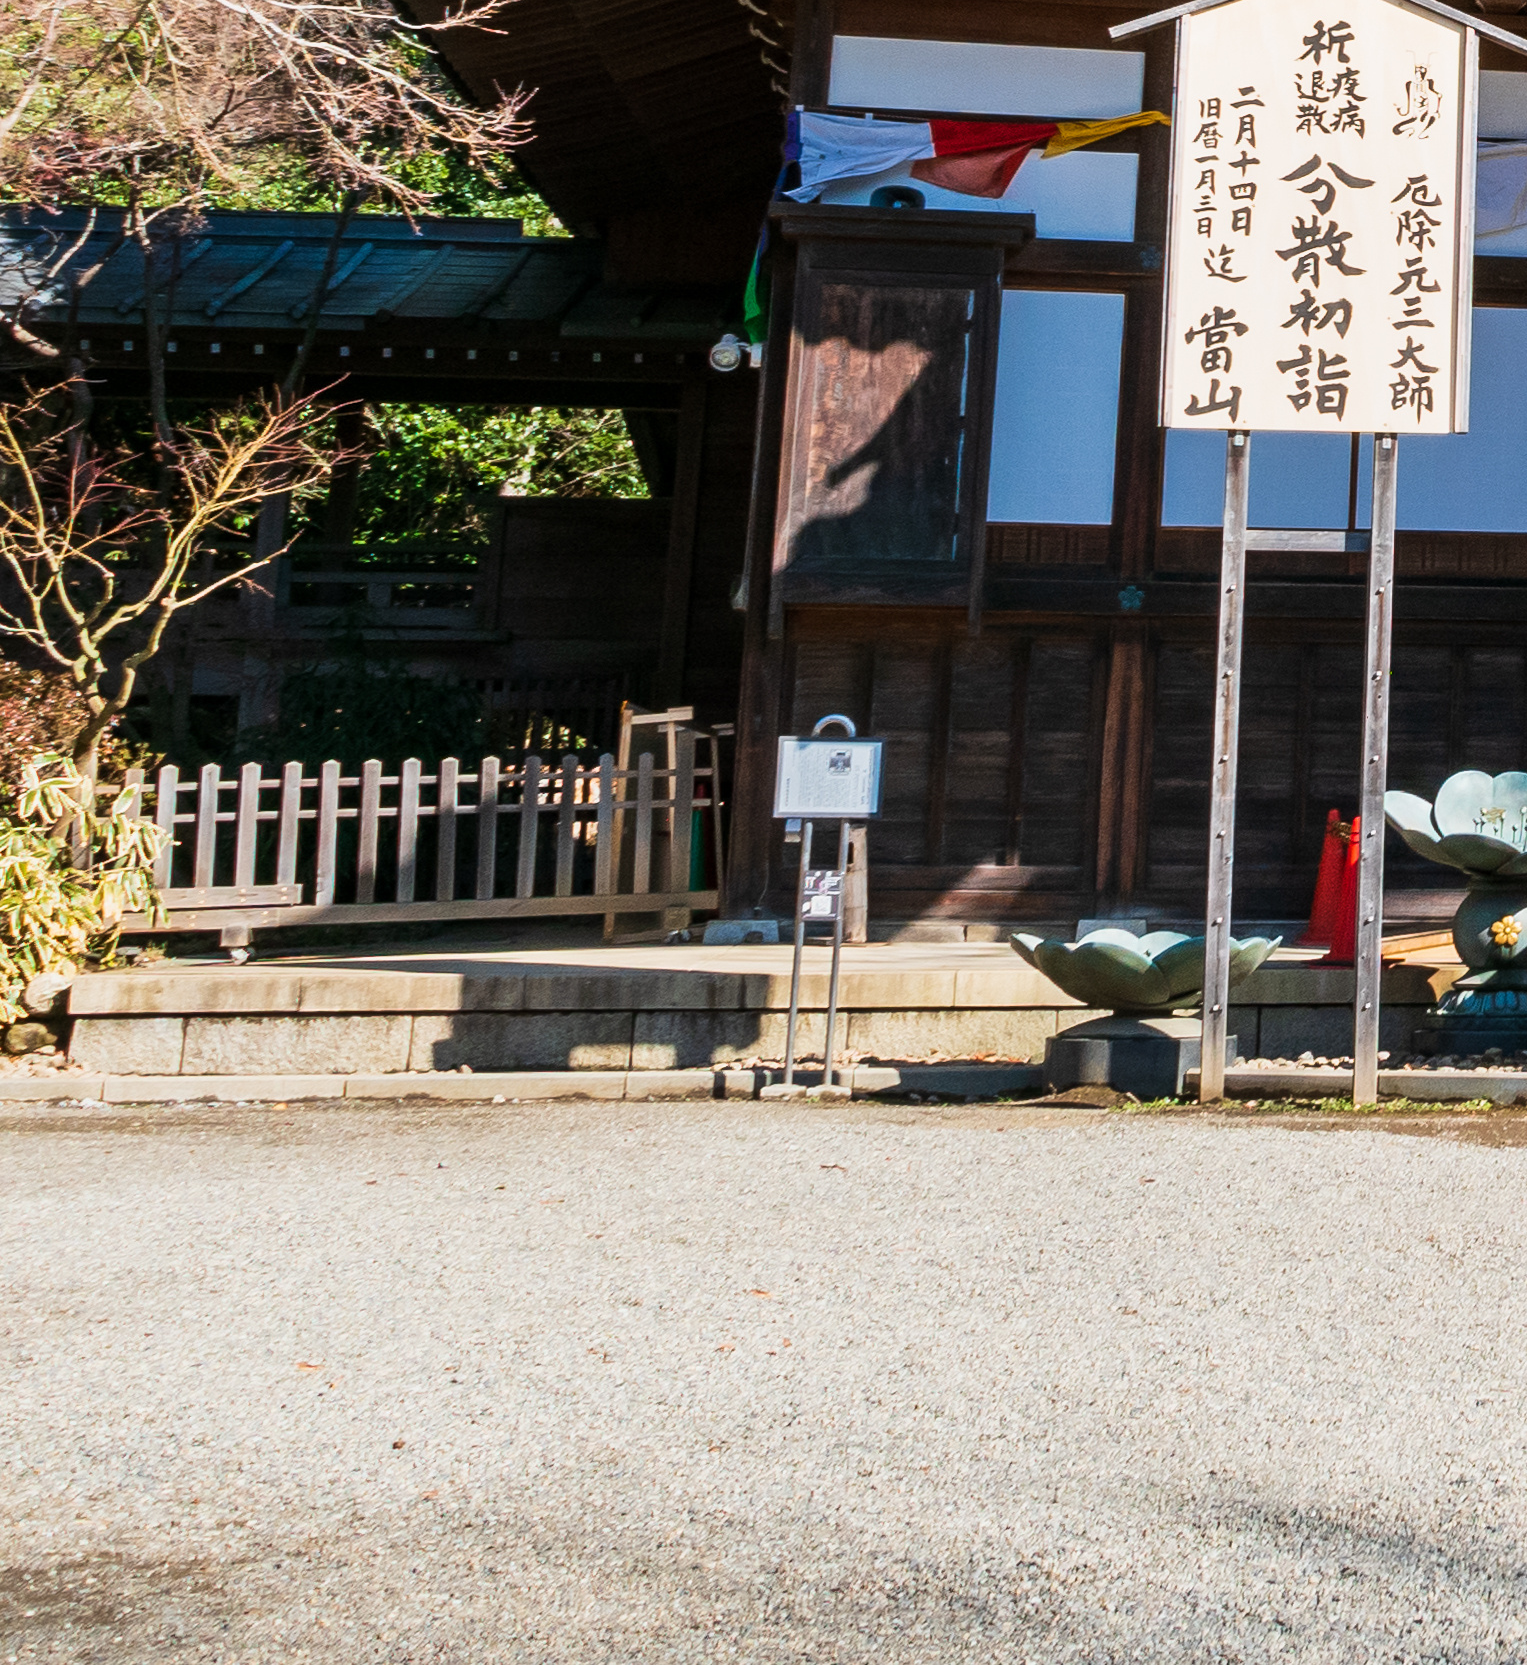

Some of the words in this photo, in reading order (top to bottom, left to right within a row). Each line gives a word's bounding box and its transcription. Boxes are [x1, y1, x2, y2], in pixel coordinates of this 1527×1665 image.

[1296, 20, 1355, 66] 祈
[1228, 86, 1265, 237] 二月十四日
[1294, 70, 1330, 137] 退散
[1328, 66, 1368, 140] 疫病
[1192, 97, 1224, 239] 旧暦一月三日
[1203, 243, 1248, 283] 迄
[1275, 154, 1376, 422] 分散初詣
[1389, 175, 1443, 424] 厄除元三大師
[1184, 305, 1249, 424] 當山
